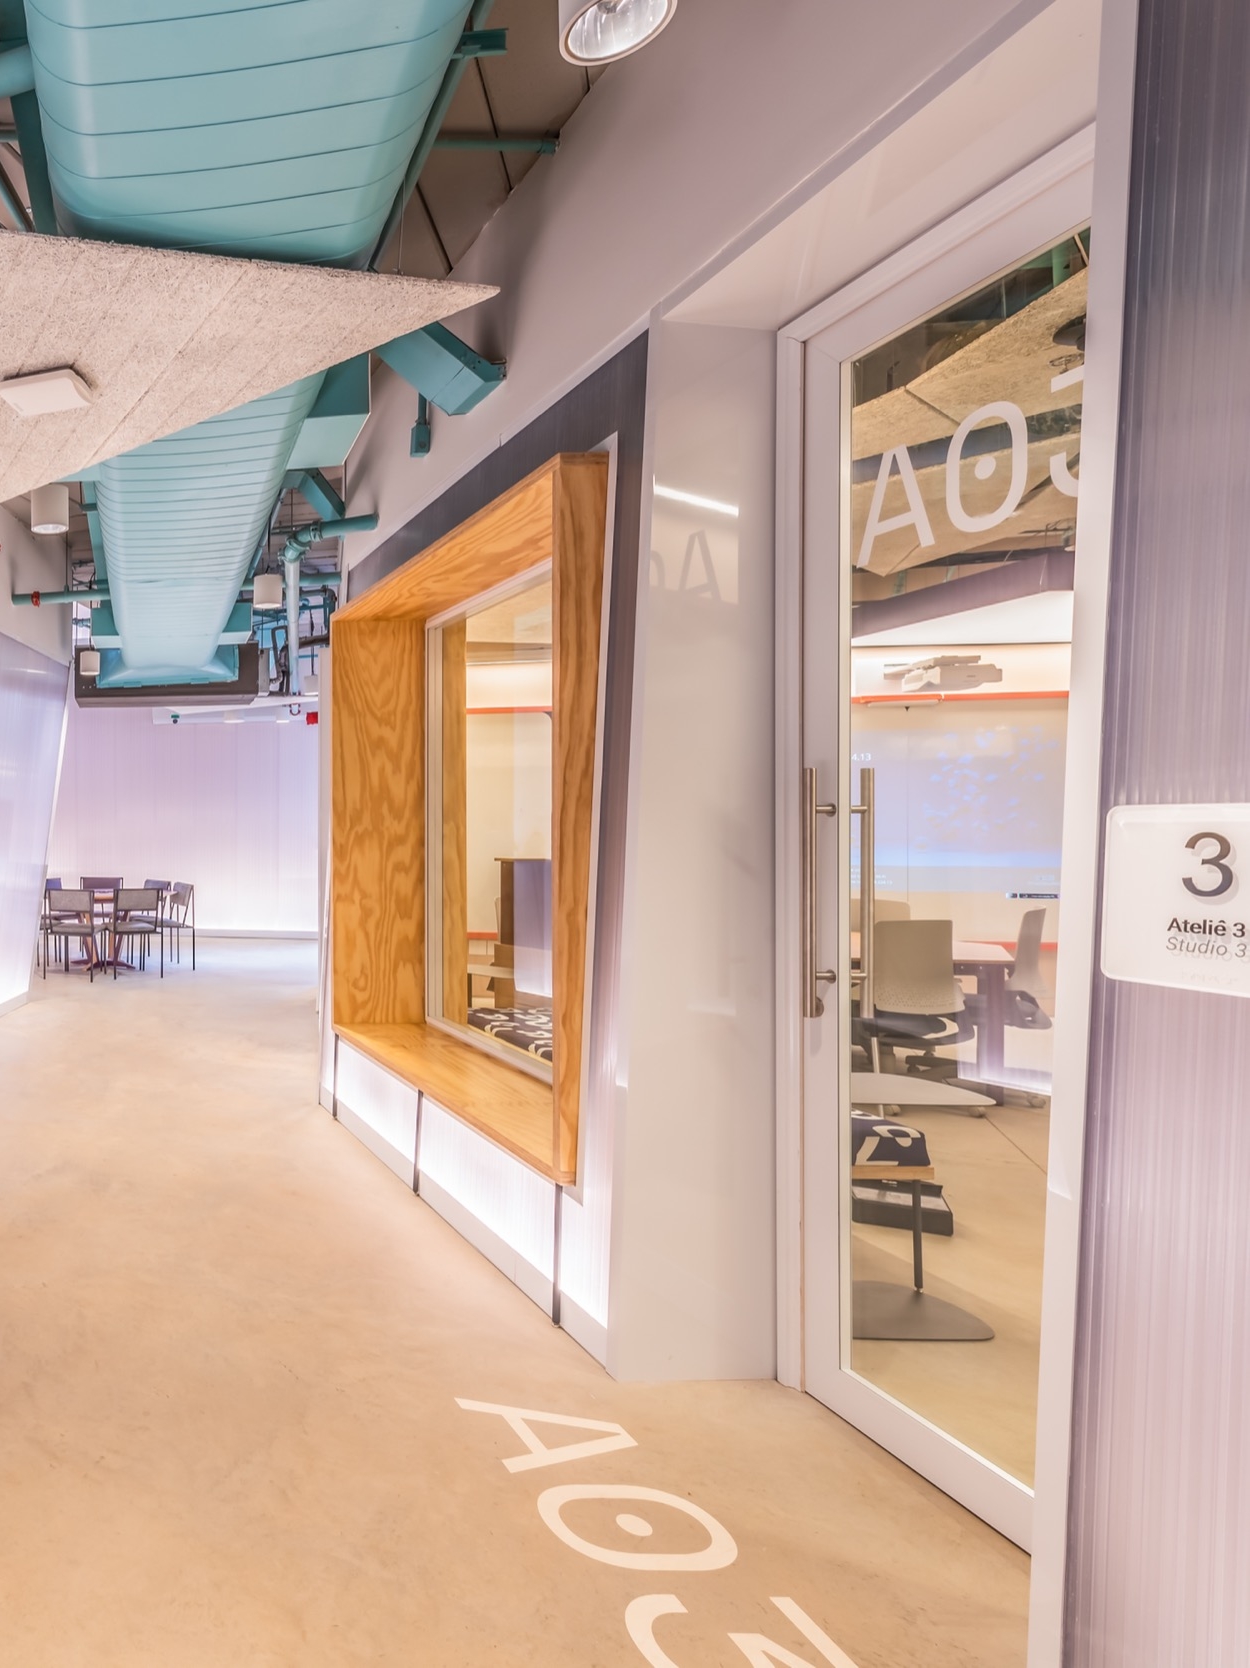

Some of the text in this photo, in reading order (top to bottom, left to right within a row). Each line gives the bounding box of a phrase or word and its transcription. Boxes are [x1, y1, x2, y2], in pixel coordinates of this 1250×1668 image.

[1181, 831, 1234, 897] 3
[1167, 917, 1246, 938] Ateliê 3
[1166, 936, 1248, 958] Studio 3
